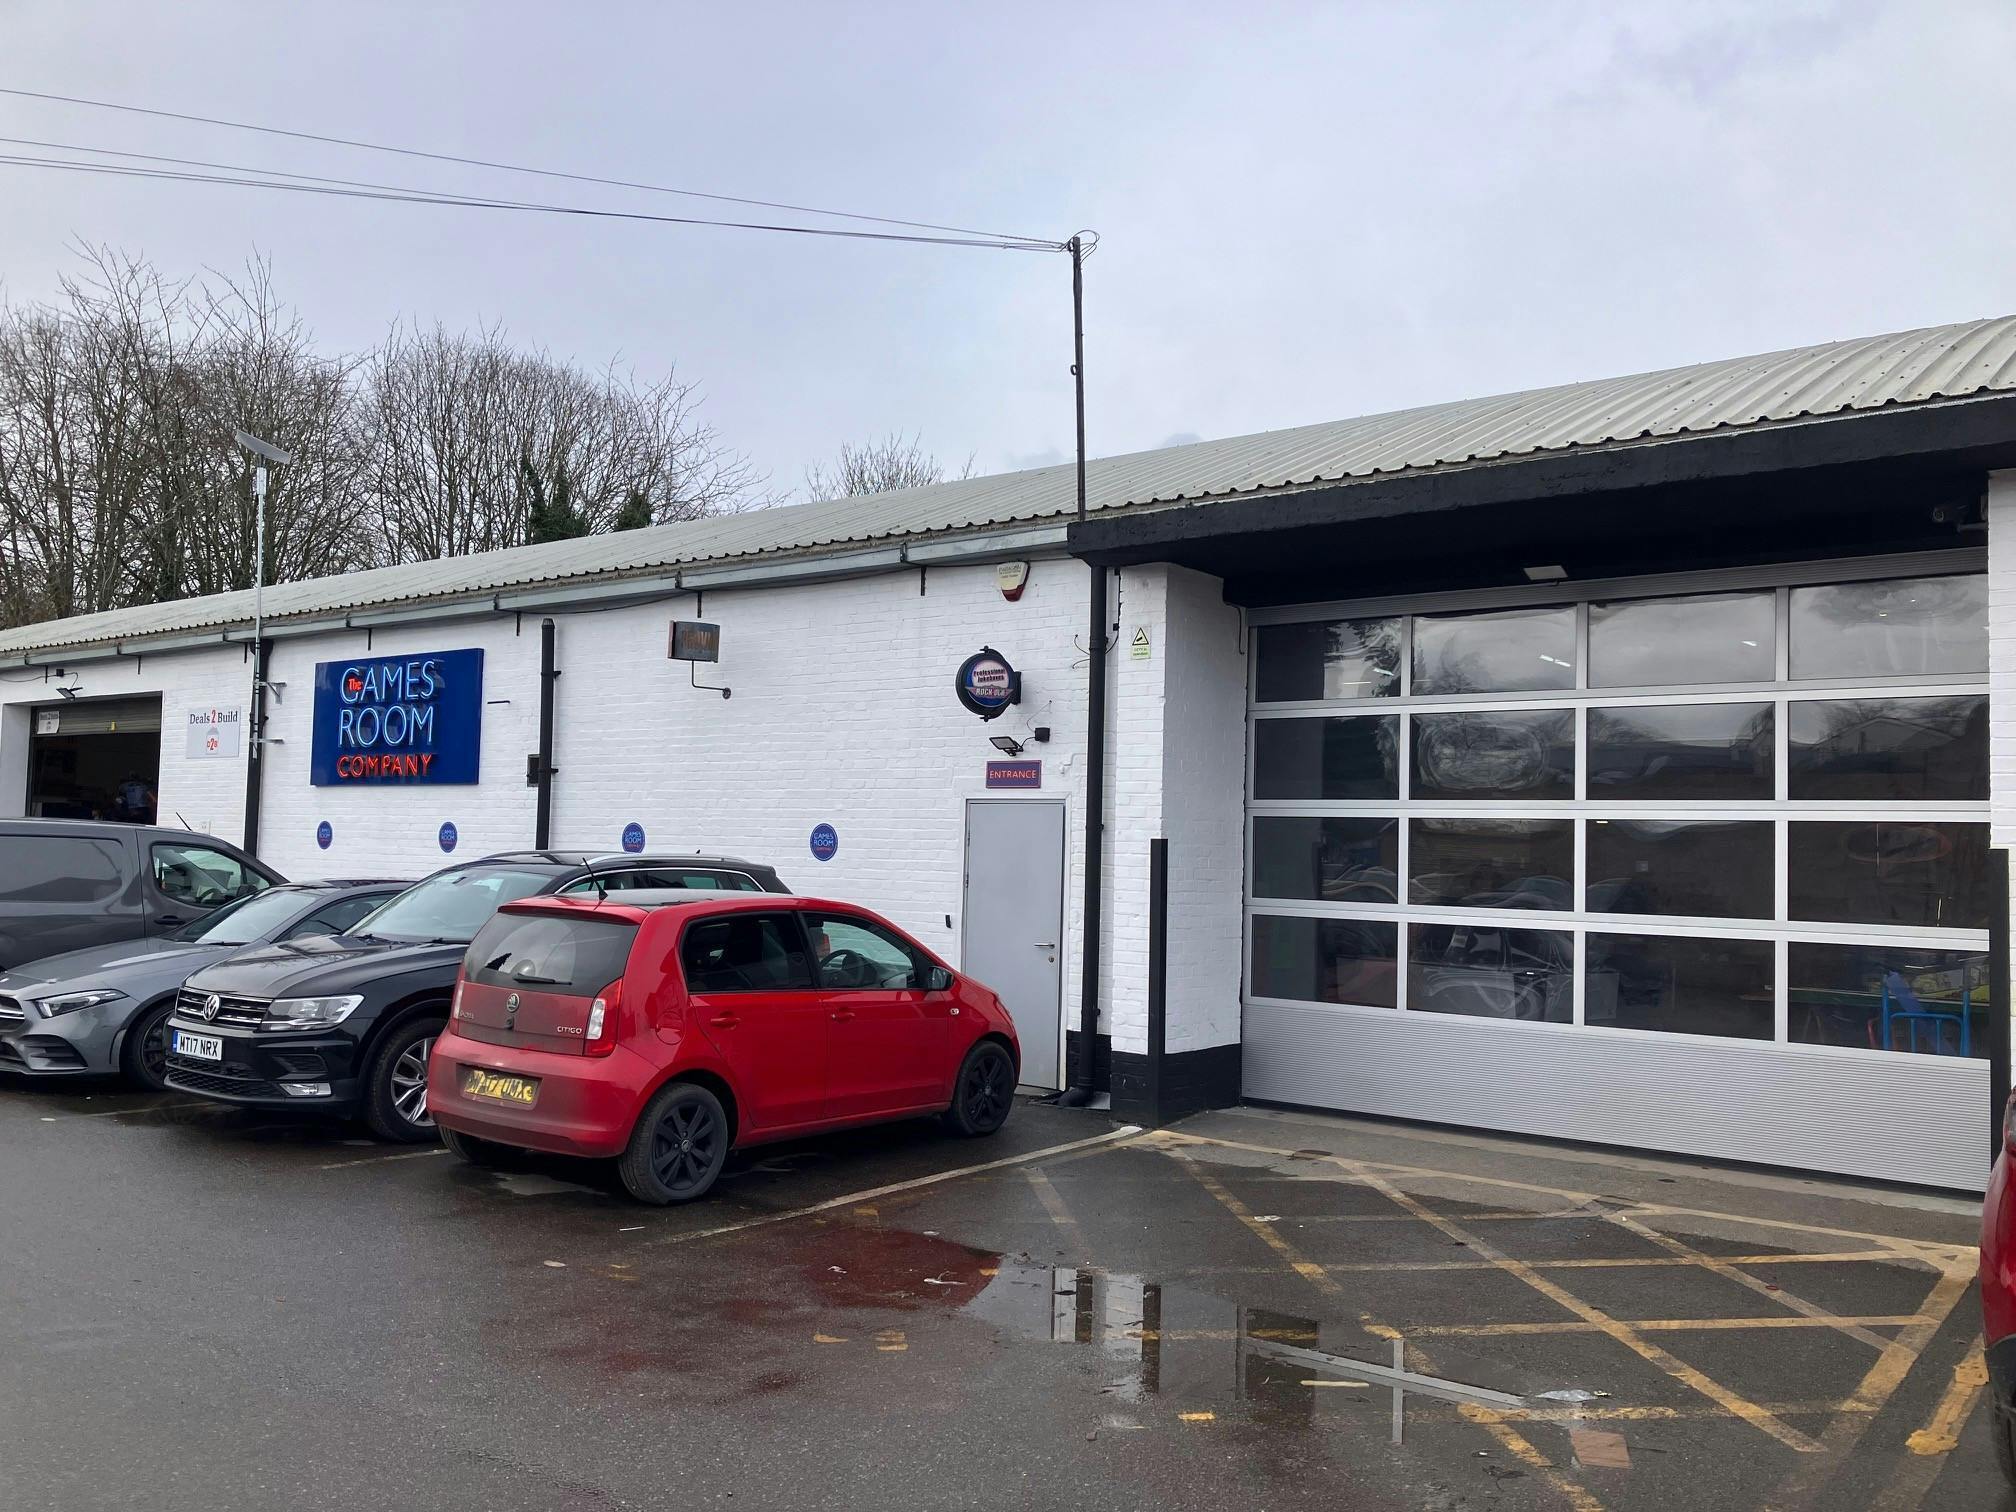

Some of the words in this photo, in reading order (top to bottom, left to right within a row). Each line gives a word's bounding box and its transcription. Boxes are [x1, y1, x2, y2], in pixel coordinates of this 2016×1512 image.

[340, 660, 436, 705] GAMES
[348, 678, 363, 692] The
[189, 712, 210, 725] Deals
[211, 709, 216, 724] 2
[217, 710, 238, 723] Build
[338, 705, 435, 748] ROOM
[337, 753, 434, 779] COMPANY
[989, 769, 1037, 779] ENTRANCE
[813, 839, 834, 847] ROOM
[557, 1025, 582, 1035] CITIGO
[180, 1035, 199, 1054] MT17
[200, 1039, 219, 1058] NRX
